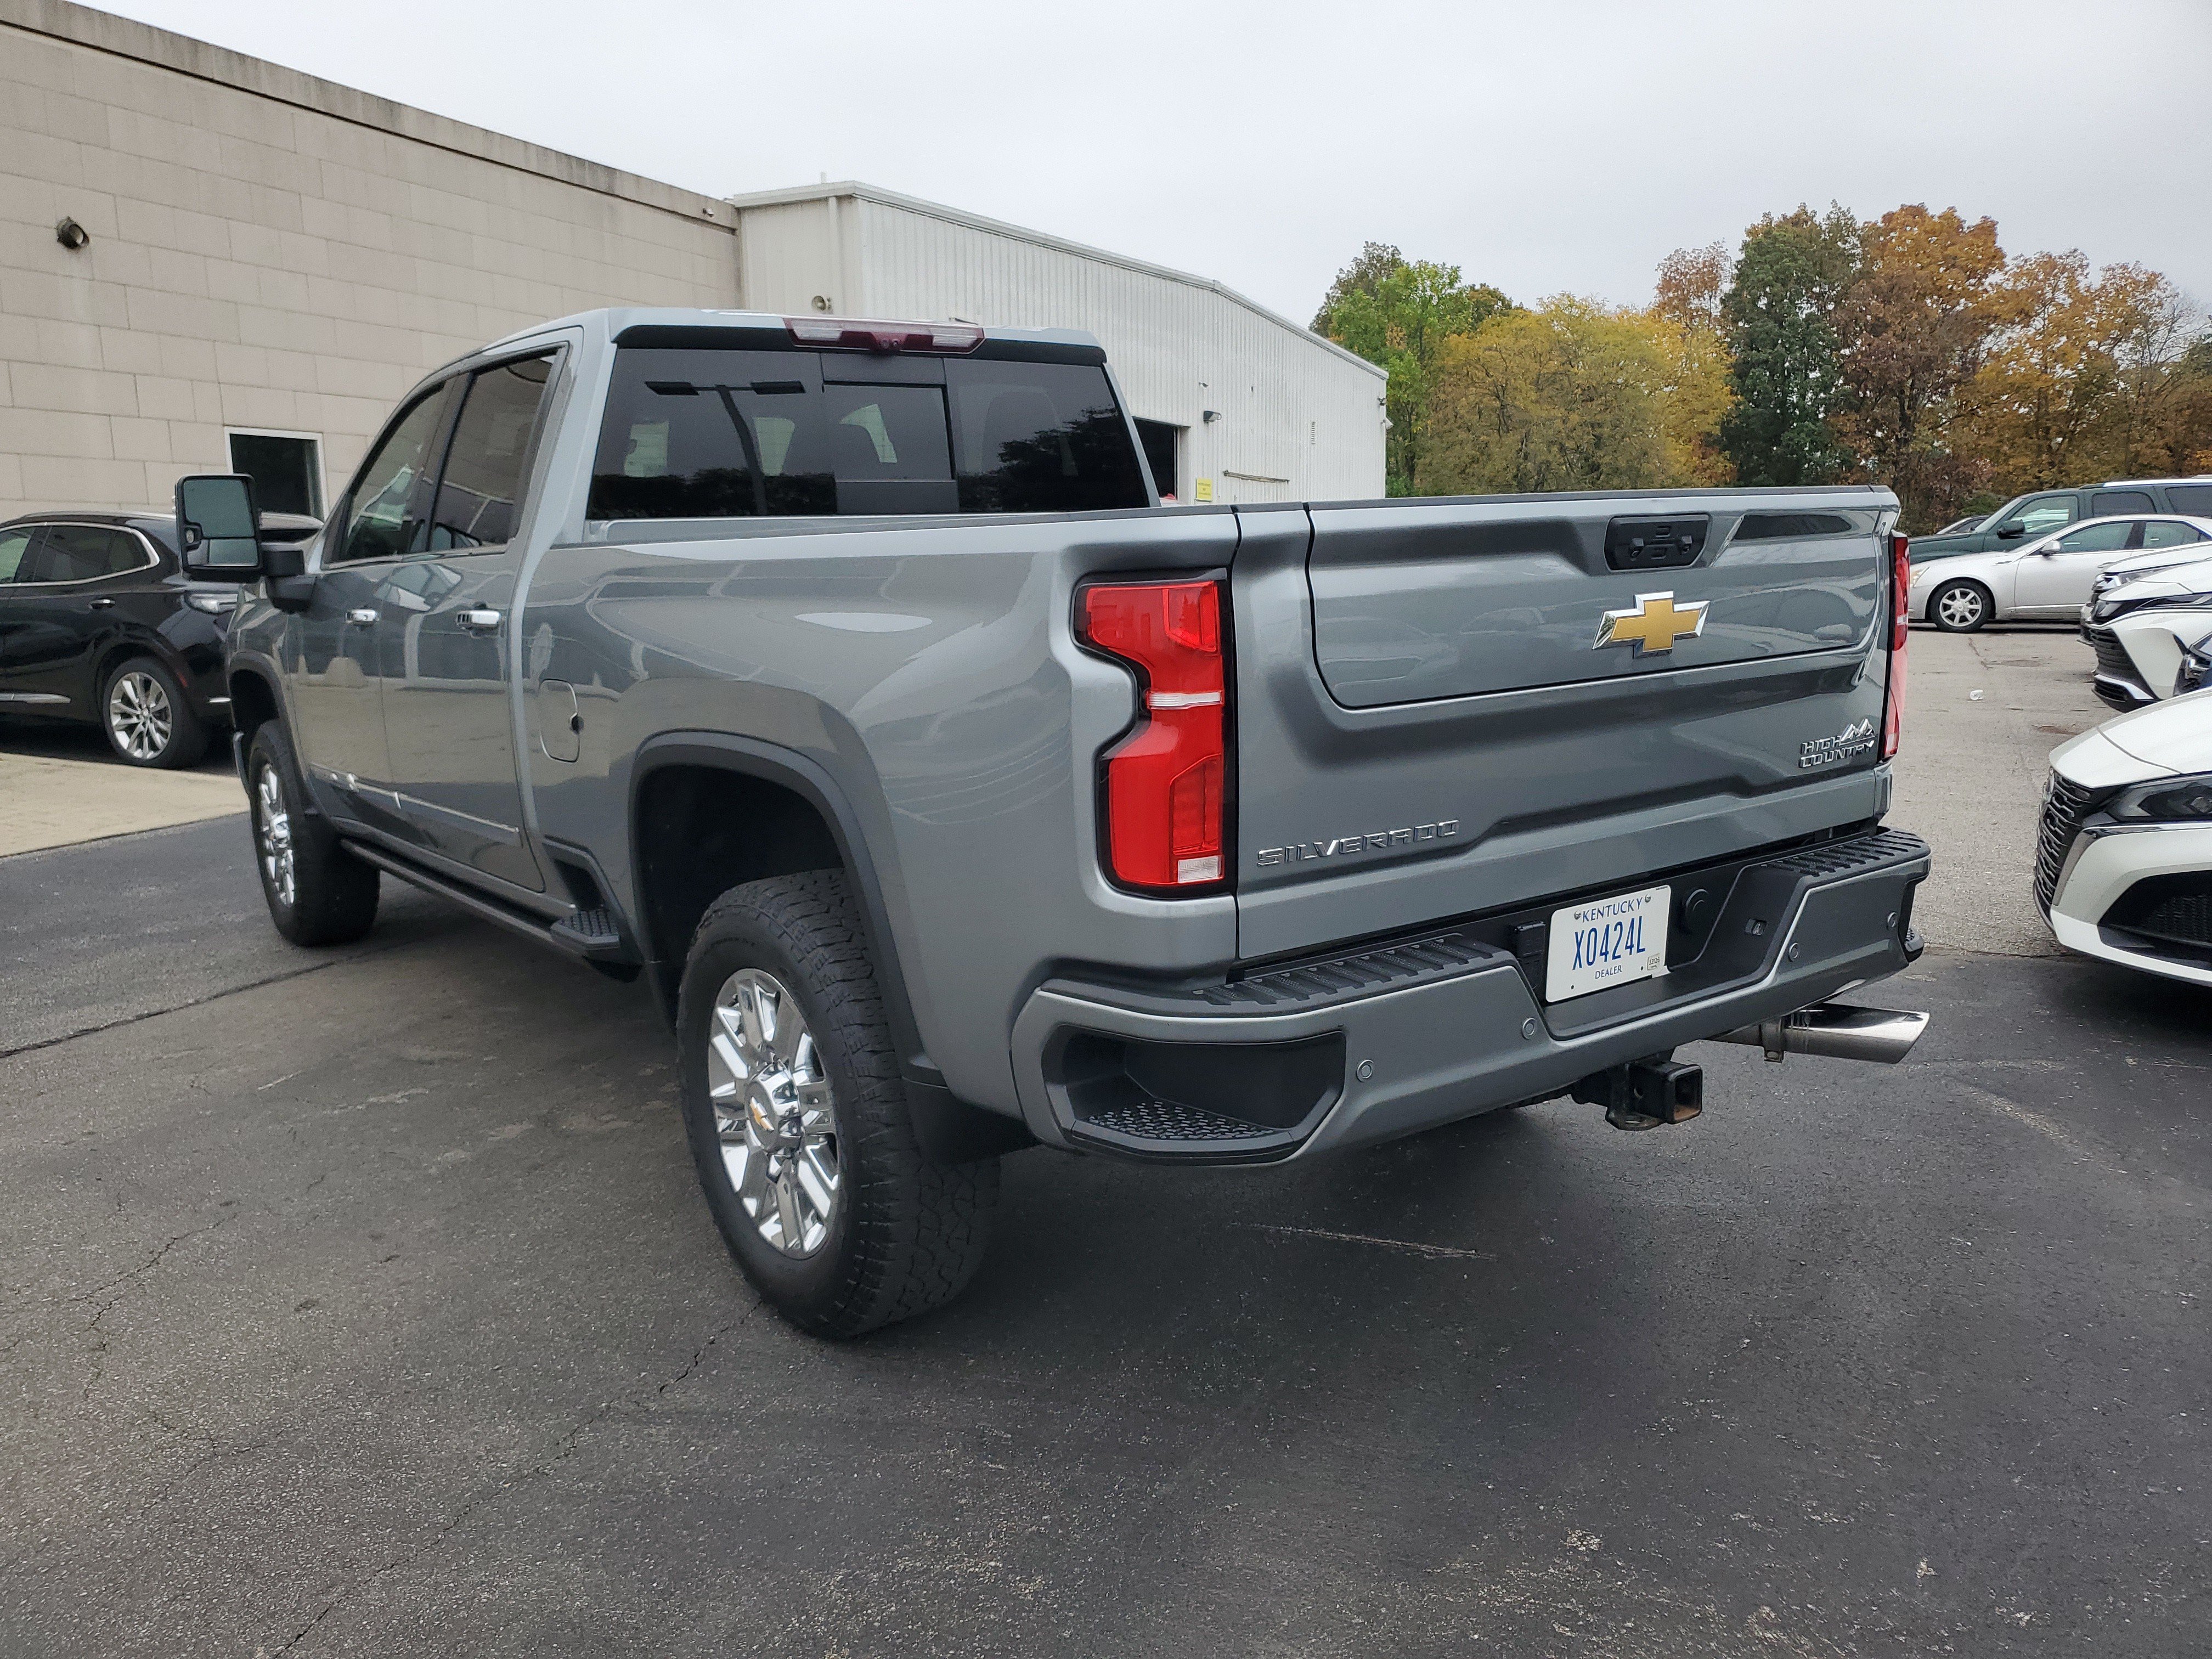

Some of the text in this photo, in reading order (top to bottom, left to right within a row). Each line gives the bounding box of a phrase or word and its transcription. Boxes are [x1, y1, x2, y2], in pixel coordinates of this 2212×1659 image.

[1798, 740, 1875, 768] COUNTRY
[1801, 735, 1843, 754] HIGH
[1257, 819, 1460, 867] SILVERADO
[1582, 897, 1643, 923] KENTUCKY
[1595, 964, 1622, 980] DEALER
